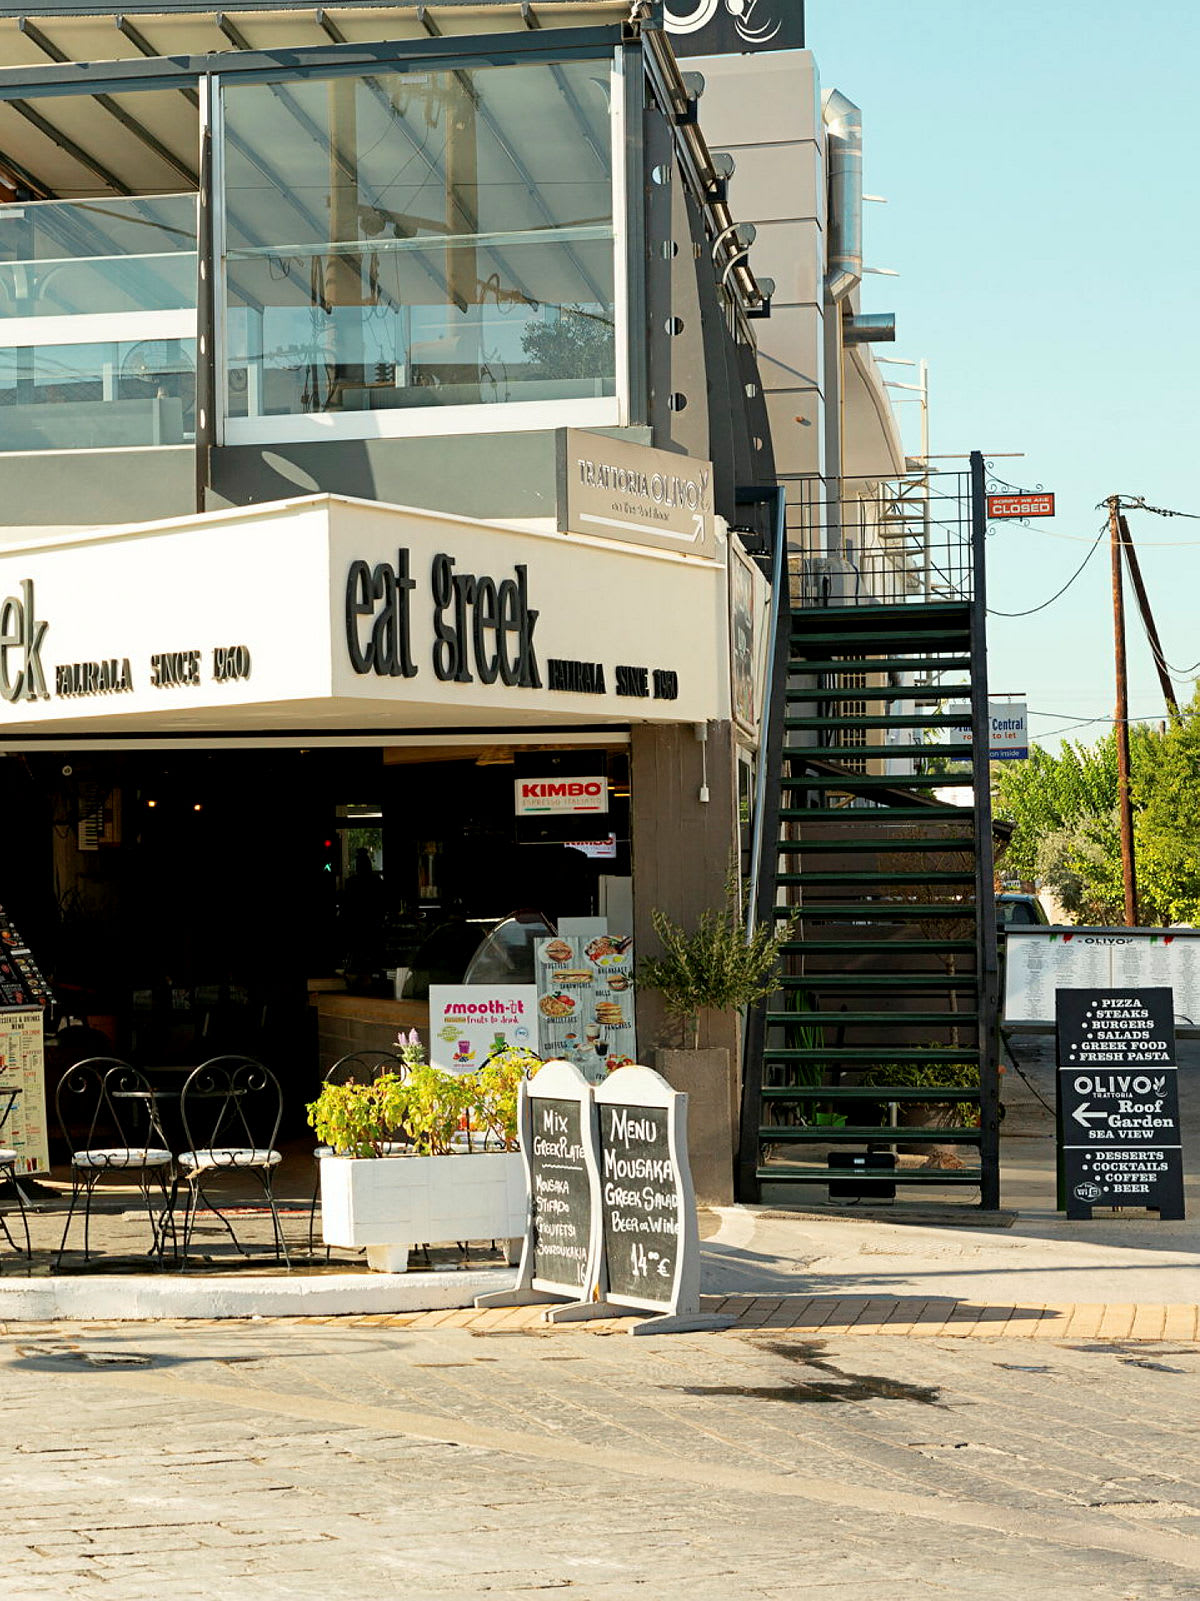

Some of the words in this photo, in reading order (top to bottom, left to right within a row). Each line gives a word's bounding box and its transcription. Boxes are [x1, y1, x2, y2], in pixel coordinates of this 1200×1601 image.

[578, 459, 649, 498] TRATTORIA
[651, 472, 699, 512] OLIVO
[992, 503, 1050, 514] CLOSED
[346, 548, 418, 678] eat
[432, 553, 543, 689] greek
[150, 650, 202, 689] SINCE
[992, 717, 1023, 731] Central
[522, 783, 601, 798] KIMBO
[1085, 937, 1126, 945] OLIVO
[1102, 999, 1142, 1008] PIZZA
[1096, 1010, 1149, 1019] STEAKS
[1091, 1020, 1155, 1029] BURGERS
[1097, 1031, 1150, 1040] SALADS
[1081, 1041, 1127, 1050] GREEK
[1130, 1041, 1167, 1050] FOOD
[1079, 1052, 1124, 1061] FRESH
[1127, 1052, 1170, 1060] PASTA
[1074, 1076, 1152, 1095] OLIVO
[1118, 1099, 1164, 1113] Roof
[1108, 1114, 1174, 1128] Garden
[1089, 1130, 1115, 1139] SEA
[1118, 1130, 1154, 1139] VIEW
[1095, 1152, 1164, 1160] DESSERTS
[605, 1150, 675, 1183] MOUSAKA
[1092, 1162, 1169, 1171] COCKTAILS
[1105, 1173, 1157, 1182] COFFEE
[1113, 1184, 1150, 1193] BEER
